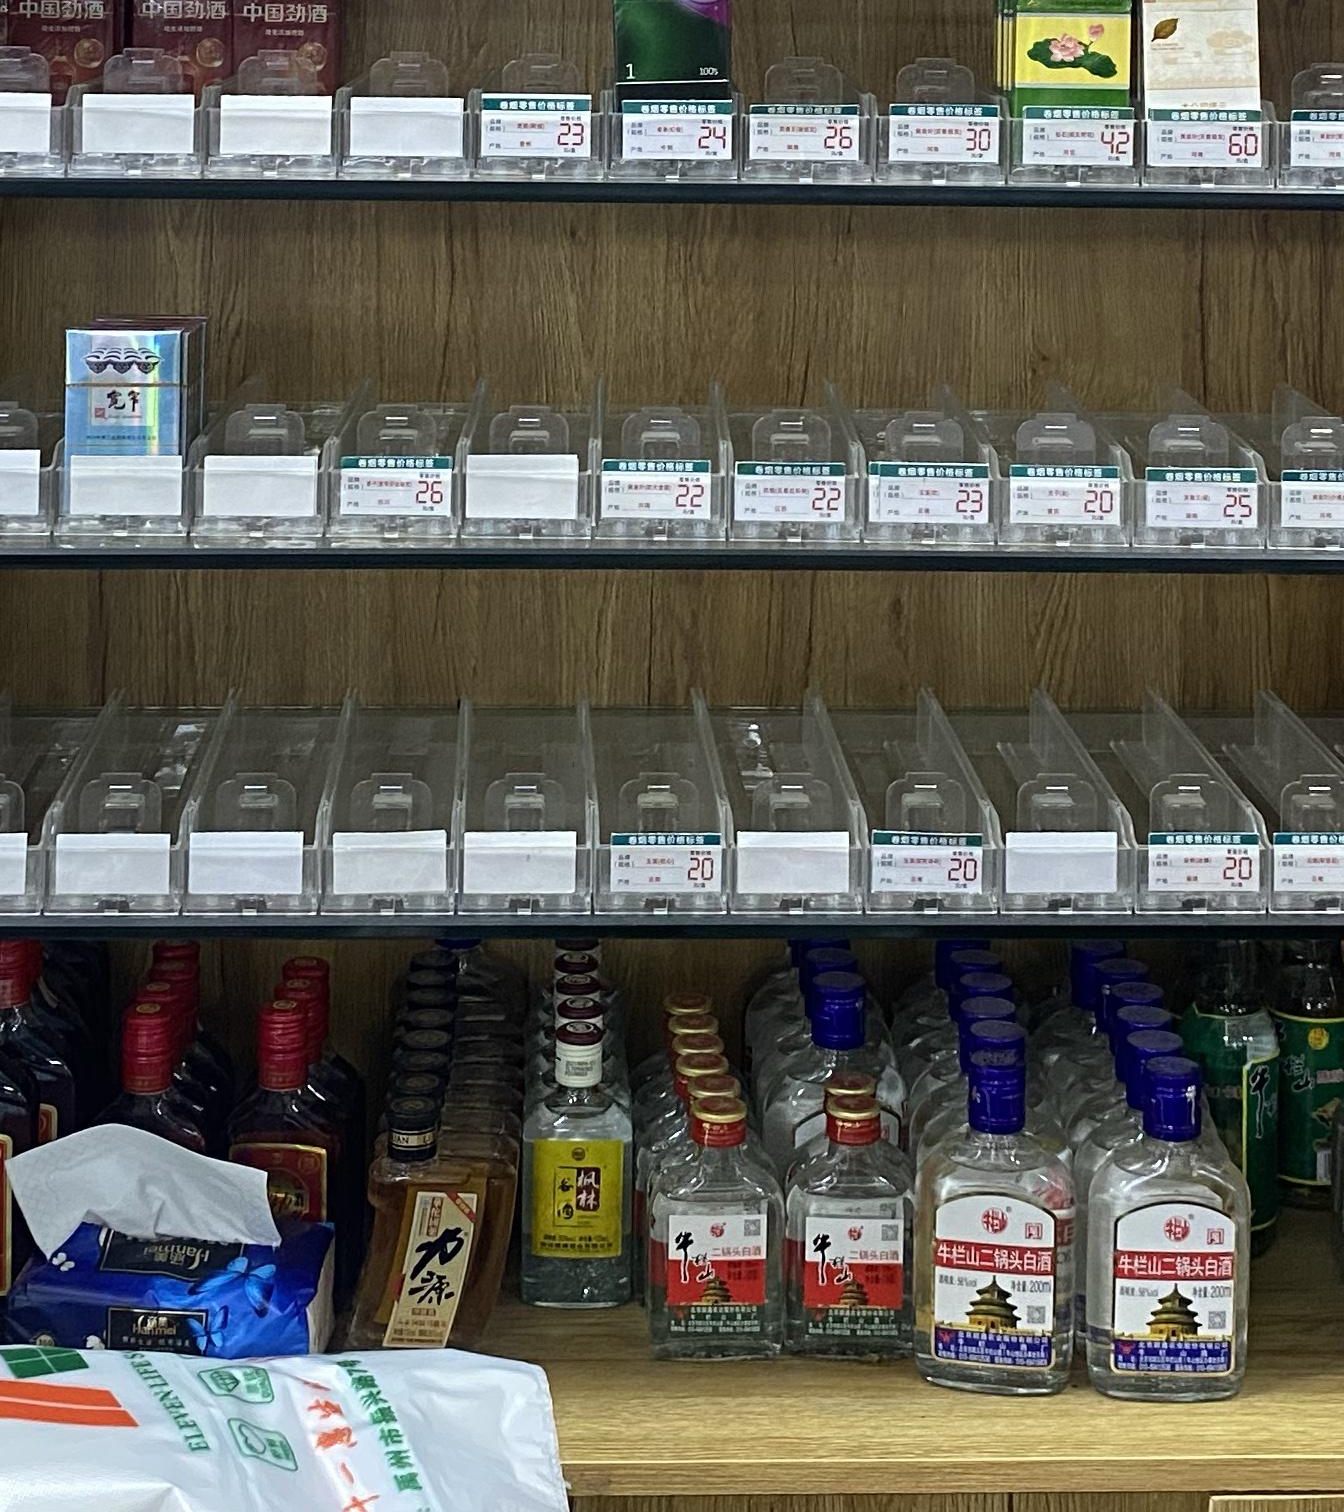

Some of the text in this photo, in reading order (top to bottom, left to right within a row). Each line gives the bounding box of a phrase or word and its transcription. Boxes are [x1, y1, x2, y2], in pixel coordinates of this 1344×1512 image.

[19, 0, 105, 21] 中国劲酒
[141, 0, 227, 21] 中国劲酒
[242, 3, 329, 25] 中国劲酒
[556, 123, 585, 147] 23
[698, 125, 727, 149] 24
[1100, 131, 1130, 154] 42
[1228, 133, 1259, 157] 60
[674, 484, 703, 508] 22
[956, 490, 984, 514] 23
[687, 856, 715, 882] 20
[938, 1244, 1052, 1273] 牛栏山二锅头白酒
[1118, 1255, 1233, 1277] 牛栏山二锅头白酒
